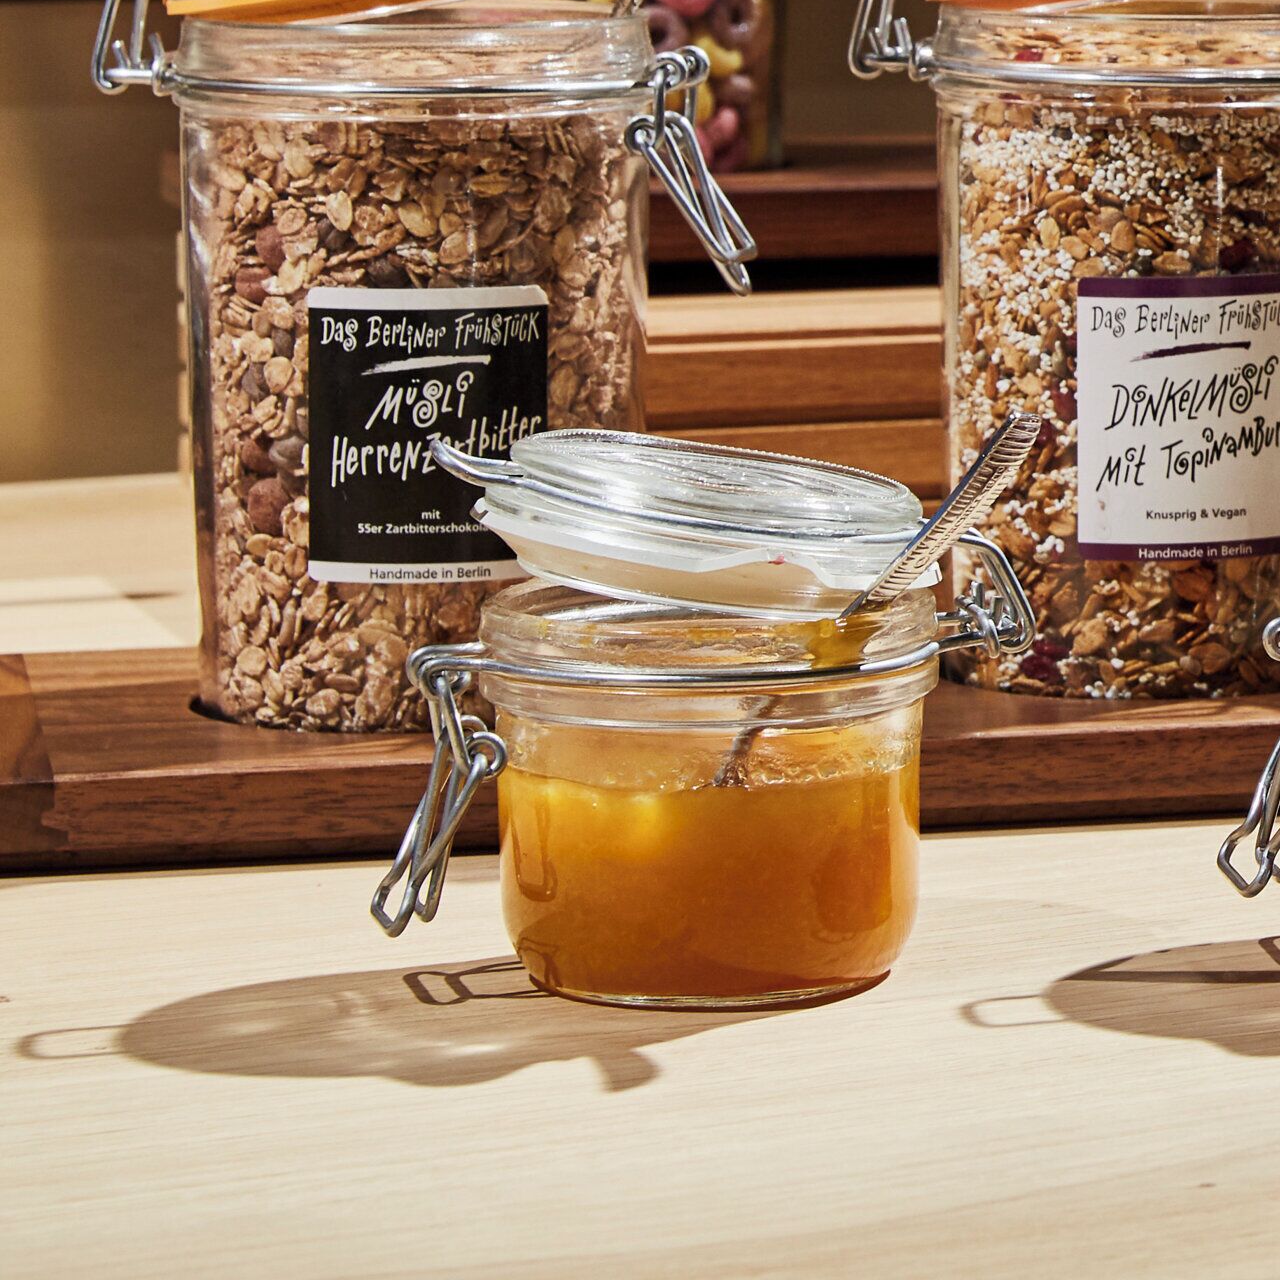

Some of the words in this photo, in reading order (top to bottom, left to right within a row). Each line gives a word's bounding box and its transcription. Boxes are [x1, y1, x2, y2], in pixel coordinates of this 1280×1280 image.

[421, 509, 440, 520] mit
[1145, 509, 1197, 522] Knusprig
[1200, 509, 1209, 519] &
[1212, 507, 1247, 520] Vegan
[357, 522, 383, 534] 55er
[385, 521, 489, 535] Zartbitterschokola
[1138, 547, 1204, 560] Handmade
[1207, 546, 1218, 557] in
[1221, 544, 1252, 557] Berlin
[369, 567, 438, 581] Handmade
[441, 567, 453, 580] in
[456, 566, 491, 579] Berlin
